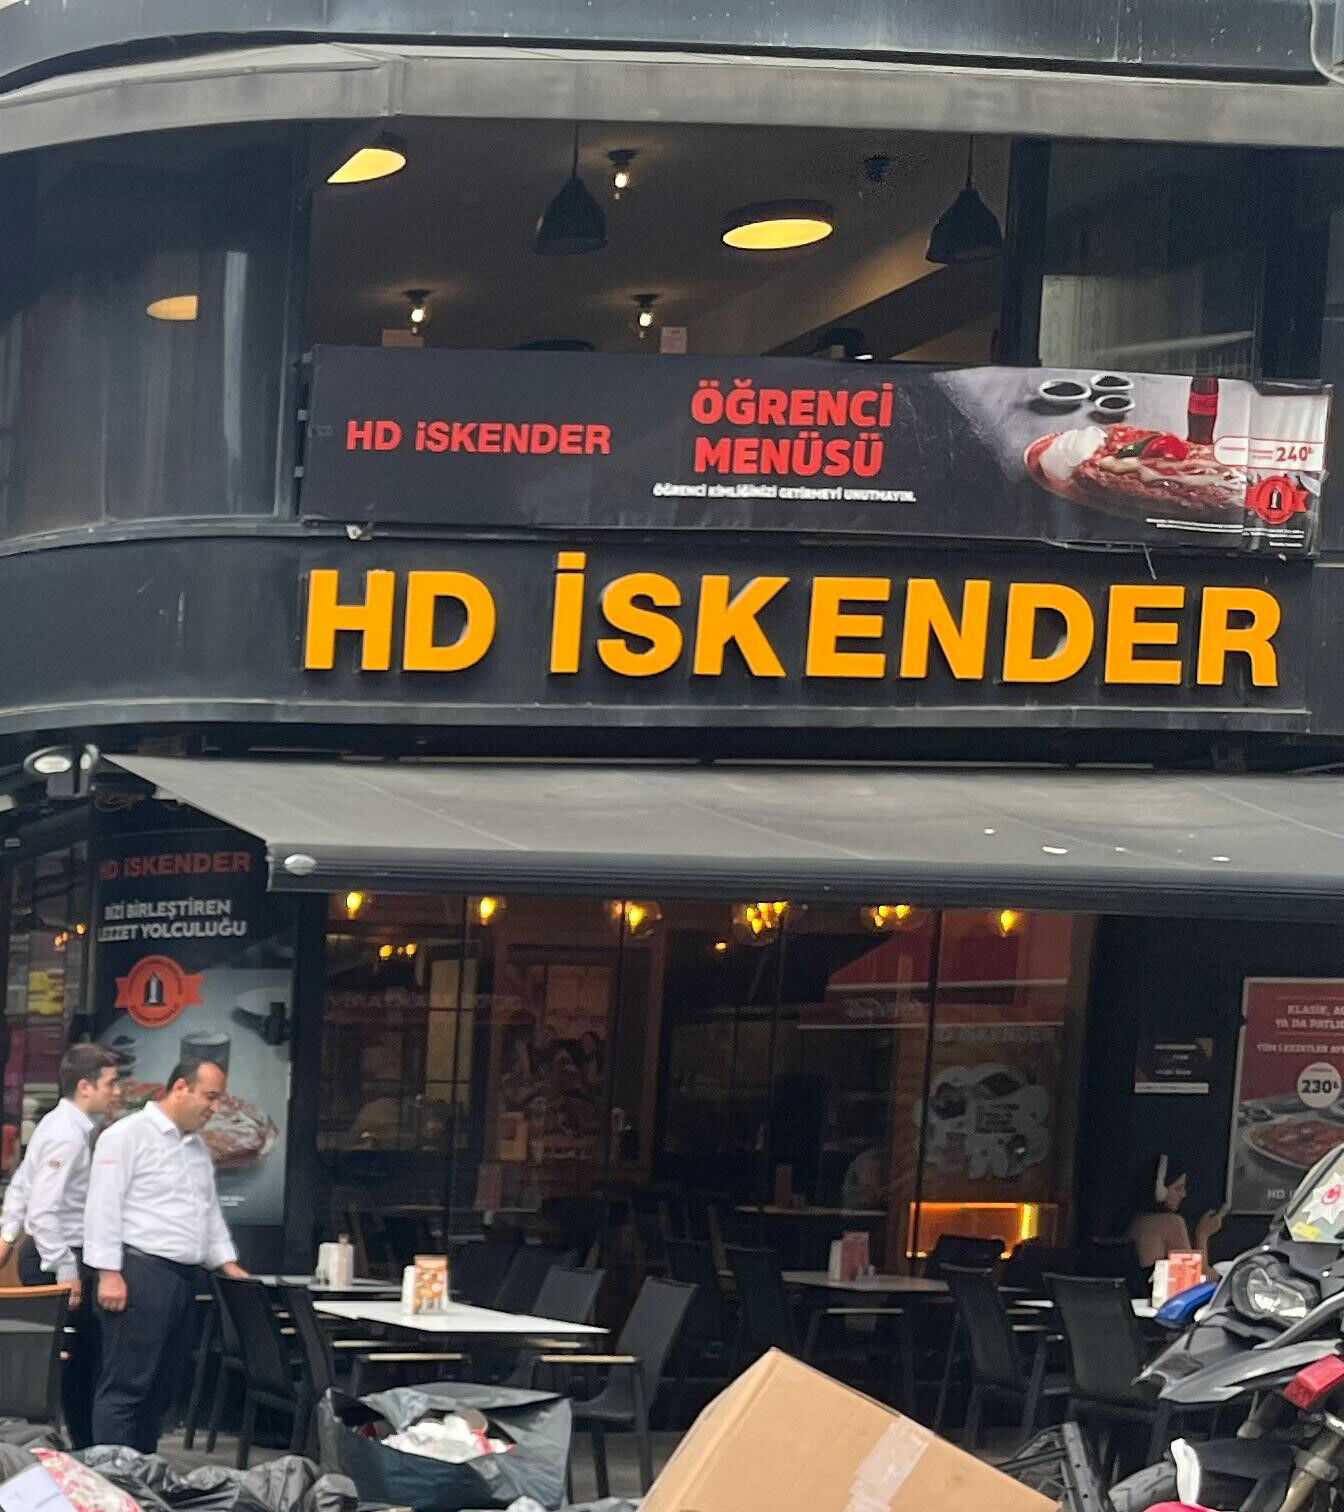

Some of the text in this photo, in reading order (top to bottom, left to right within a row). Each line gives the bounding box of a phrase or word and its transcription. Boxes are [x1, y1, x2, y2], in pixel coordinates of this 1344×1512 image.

[691, 378, 895, 428] ÖĞRENCİ
[346, 420, 403, 451] HD
[693, 431, 885, 477] MENÜSÜ
[305, 551, 1281, 689] HD İSKENDER
[126, 896, 232, 920] BİRLEŞTİREN
[141, 916, 248, 939] YOLCULUĞU
